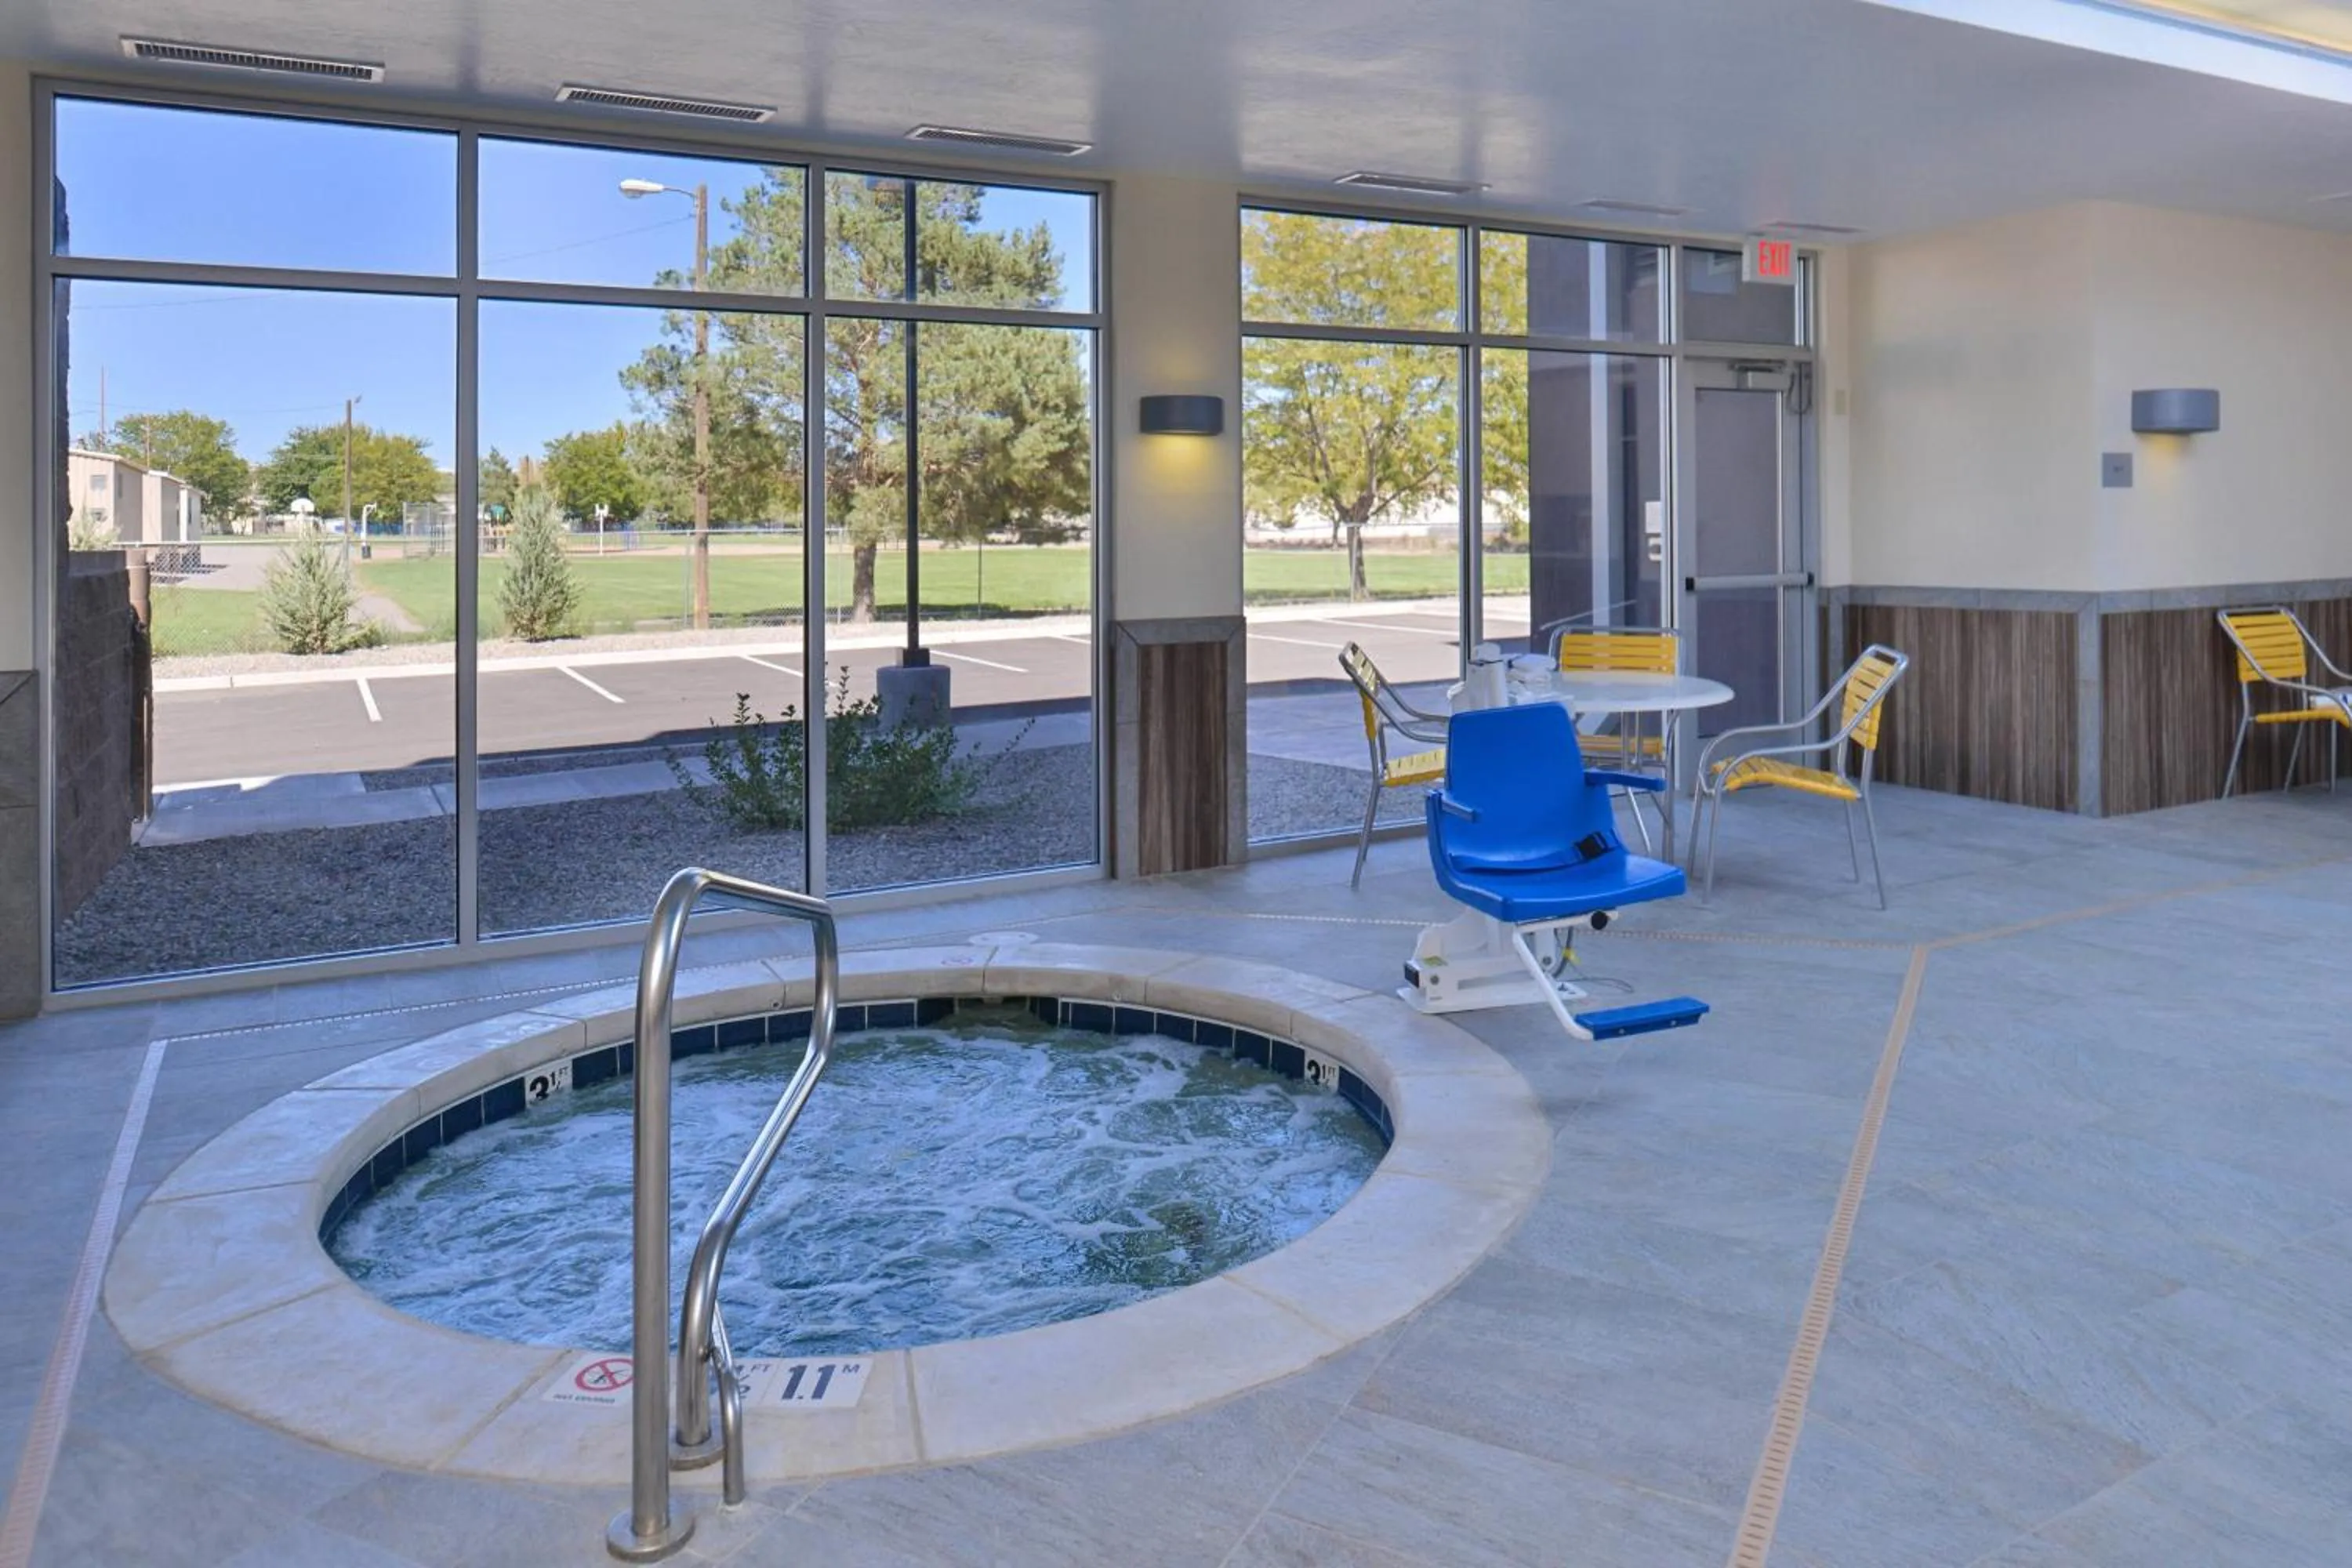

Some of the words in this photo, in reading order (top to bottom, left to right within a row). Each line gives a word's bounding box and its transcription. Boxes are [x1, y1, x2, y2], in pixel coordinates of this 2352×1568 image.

[1759, 240, 1791, 276] EXIT
[782, 1364, 837, 1399] 1.1
[842, 1364, 860, 1374] M
